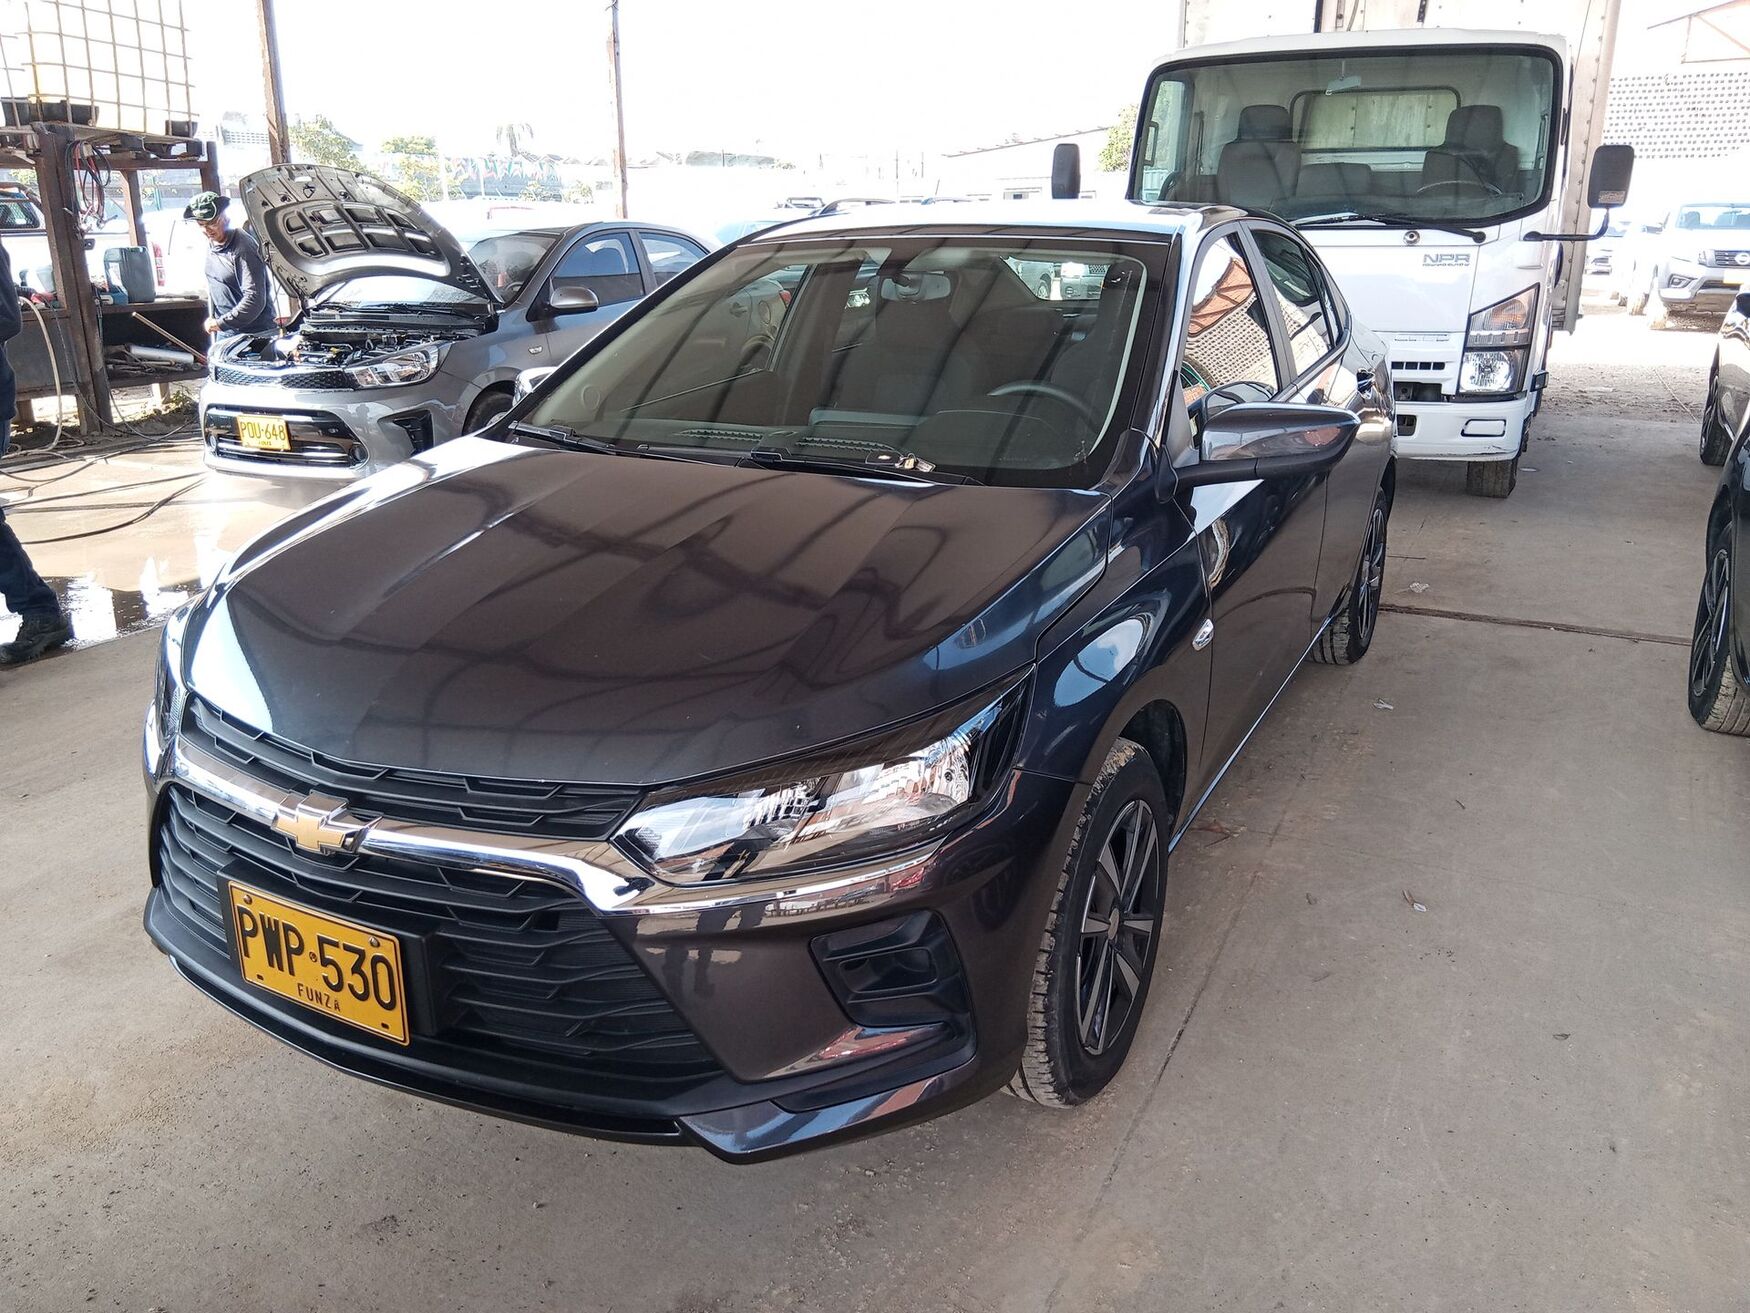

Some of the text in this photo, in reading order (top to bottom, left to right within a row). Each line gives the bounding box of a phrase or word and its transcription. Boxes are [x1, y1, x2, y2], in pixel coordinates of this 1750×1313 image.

[1423, 253, 1470, 263] NPR
[264, 423, 286, 441] 648
[237, 905, 397, 1011] PWP 530
[297, 982, 342, 1012] FUNZA
